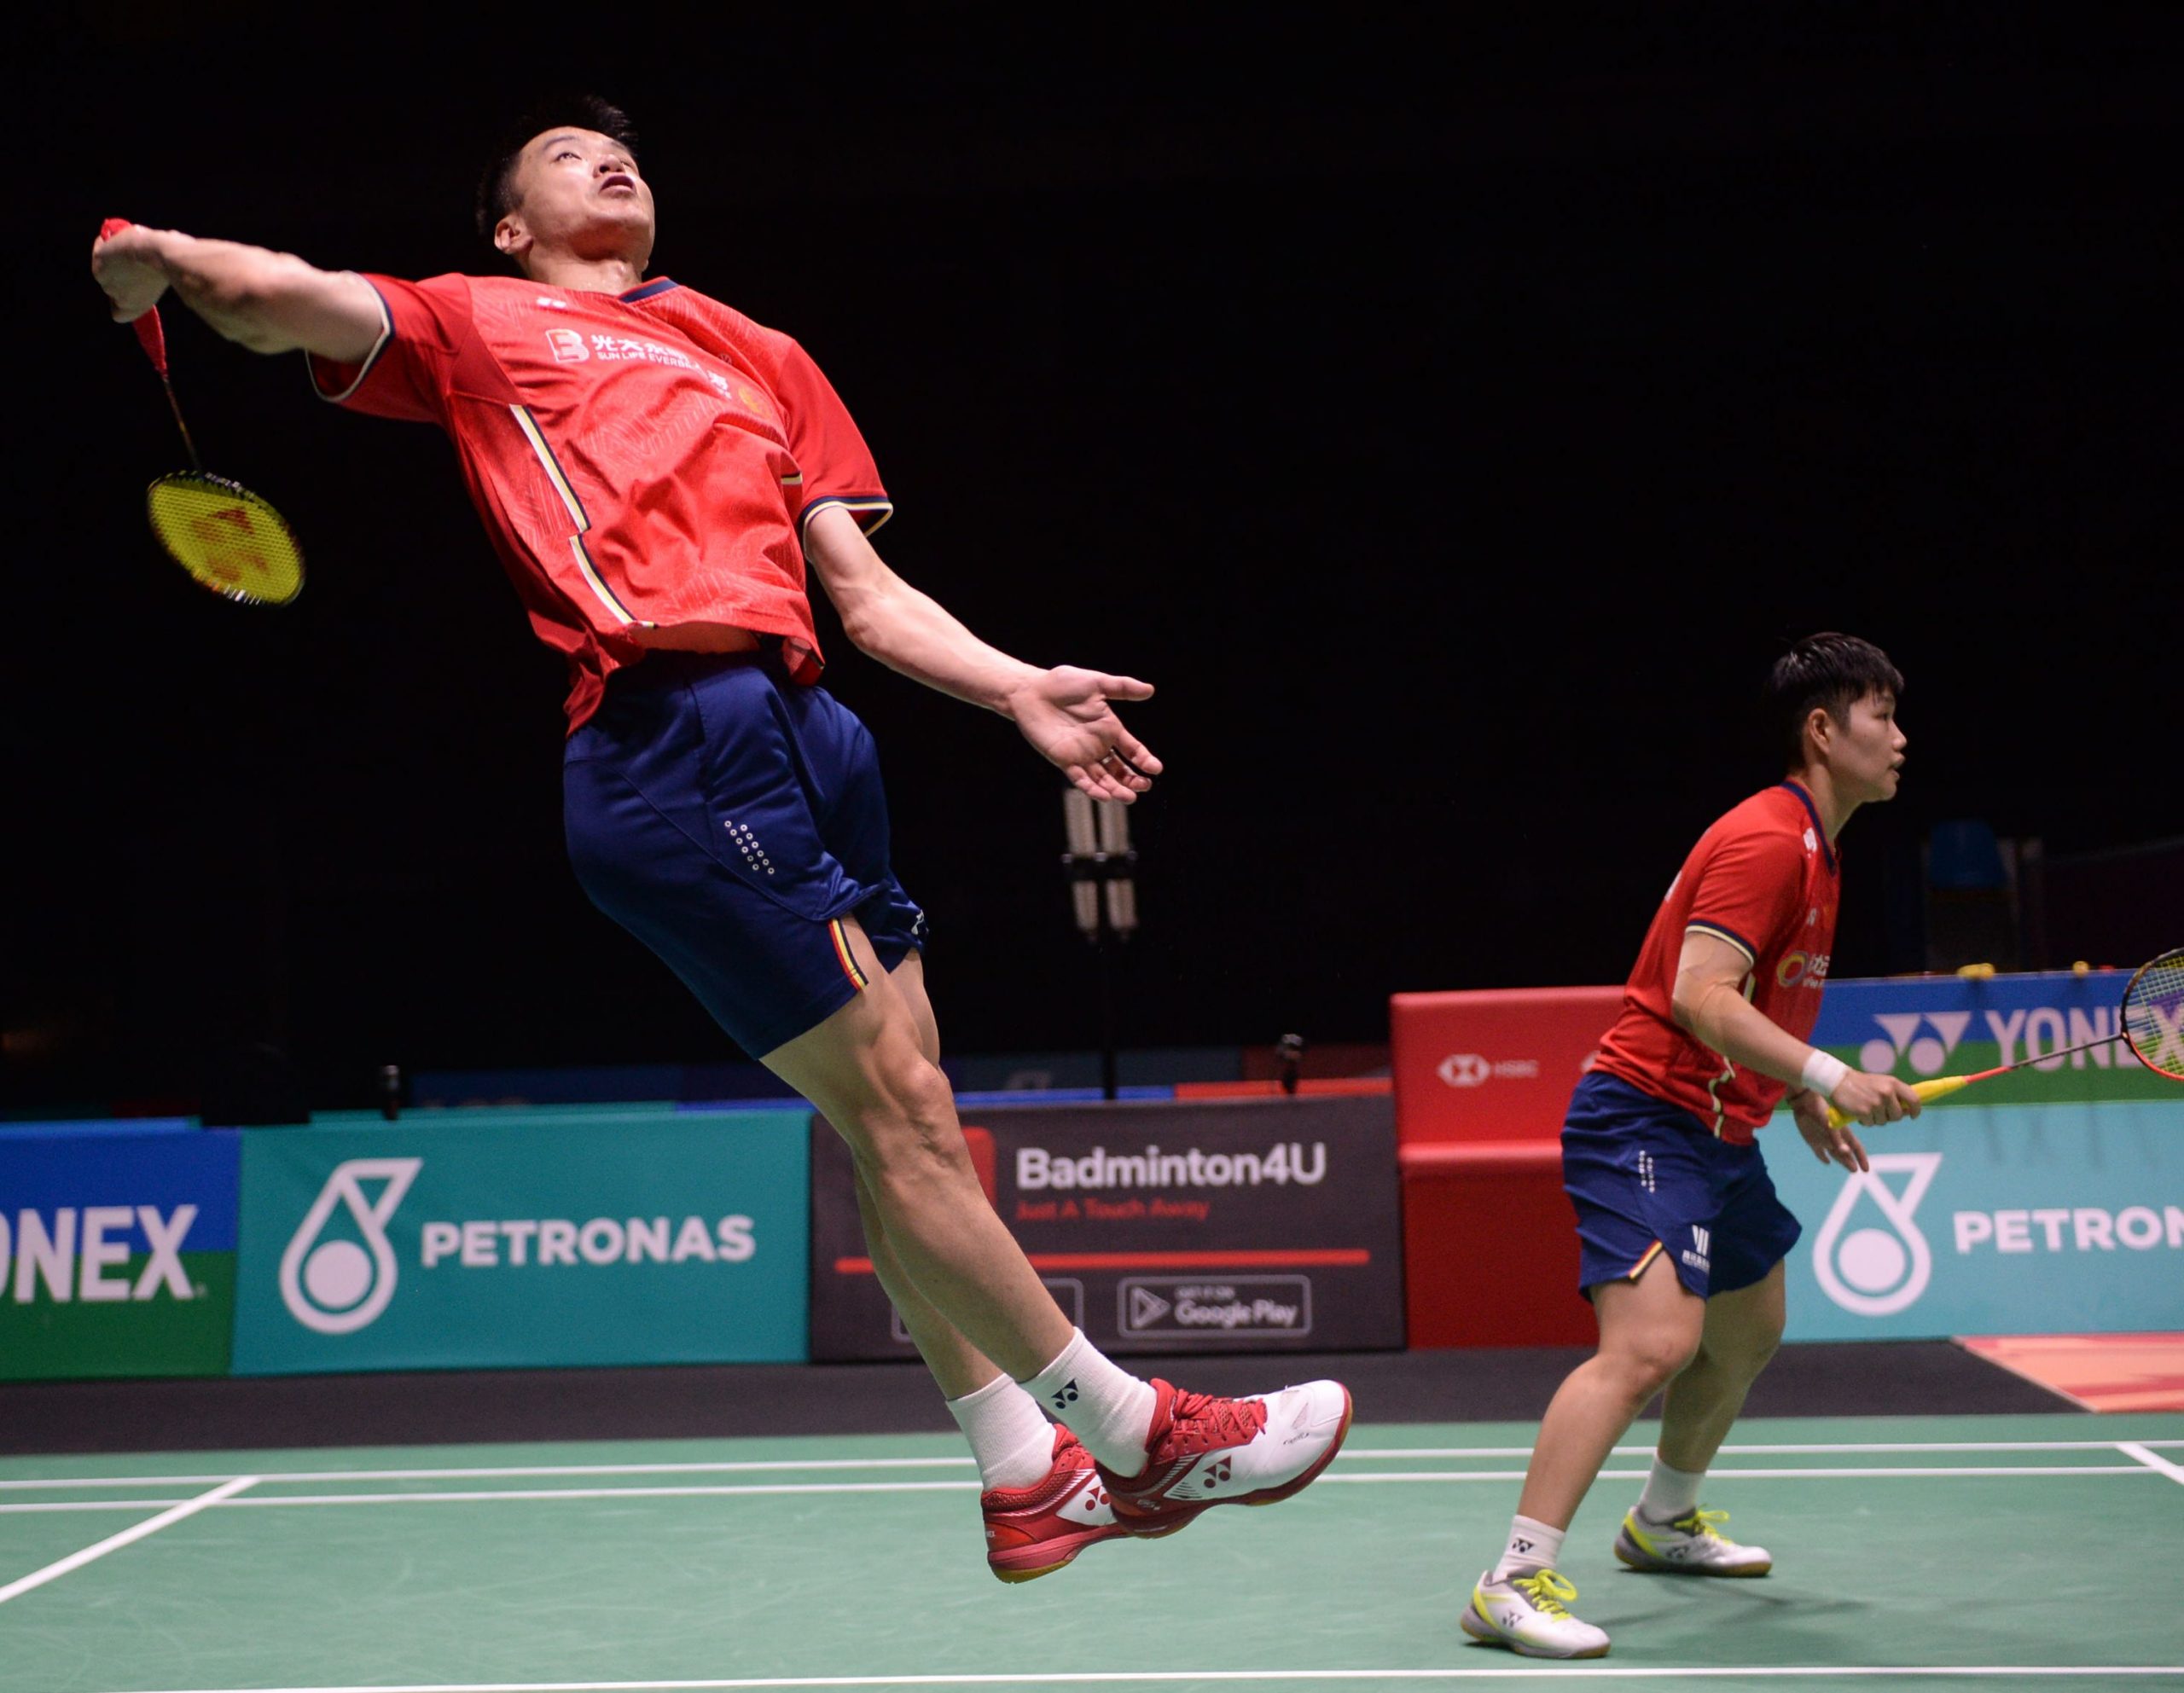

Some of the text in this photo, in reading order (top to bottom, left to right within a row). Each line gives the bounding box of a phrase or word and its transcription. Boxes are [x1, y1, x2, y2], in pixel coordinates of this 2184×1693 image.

[1016, 1141, 1327, 1190] Badminton4U
[1060, 1199, 1081, 1220] A
[1083, 1197, 1147, 1220] Touch
[1149, 1197, 1211, 1222] Away
[0, 1203, 200, 1304] NEX
[421, 1214, 758, 1268] PETRONAS
[1174, 1298, 1298, 1329] Google Play
